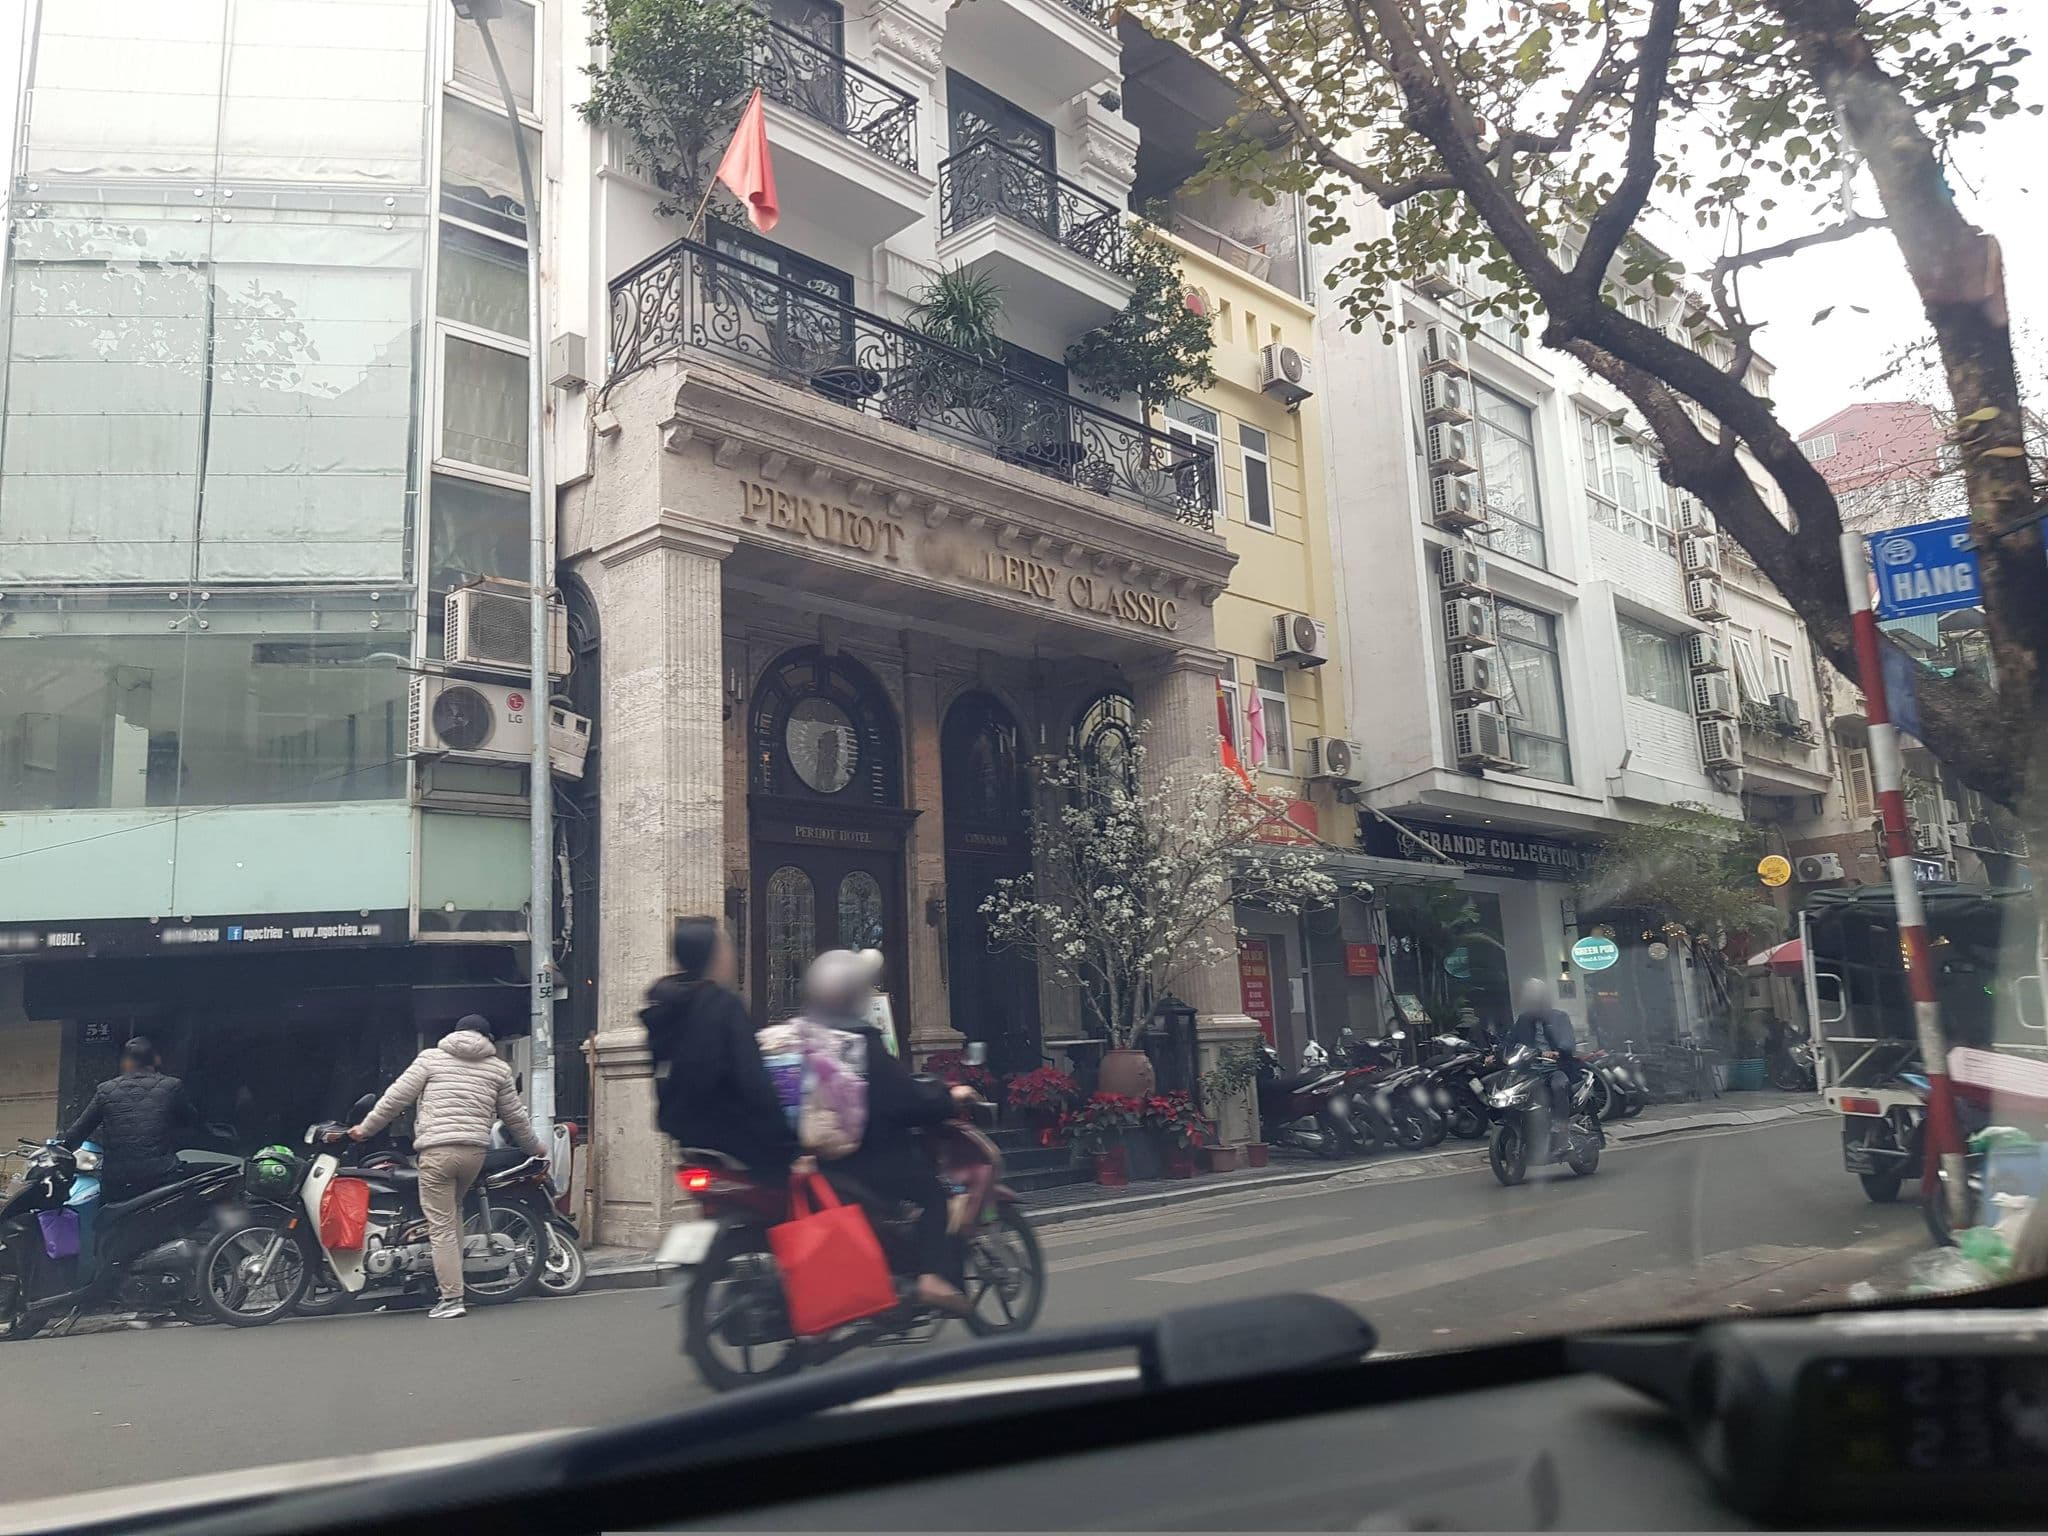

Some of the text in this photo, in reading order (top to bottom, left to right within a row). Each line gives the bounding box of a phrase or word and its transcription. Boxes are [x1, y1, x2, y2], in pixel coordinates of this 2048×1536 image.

[1892, 562, 1975, 602] HÀNG
[1068, 575, 1179, 631] CLASSIC
[508, 714, 523, 724] LG
[1419, 830, 1486, 858] GRANDE
